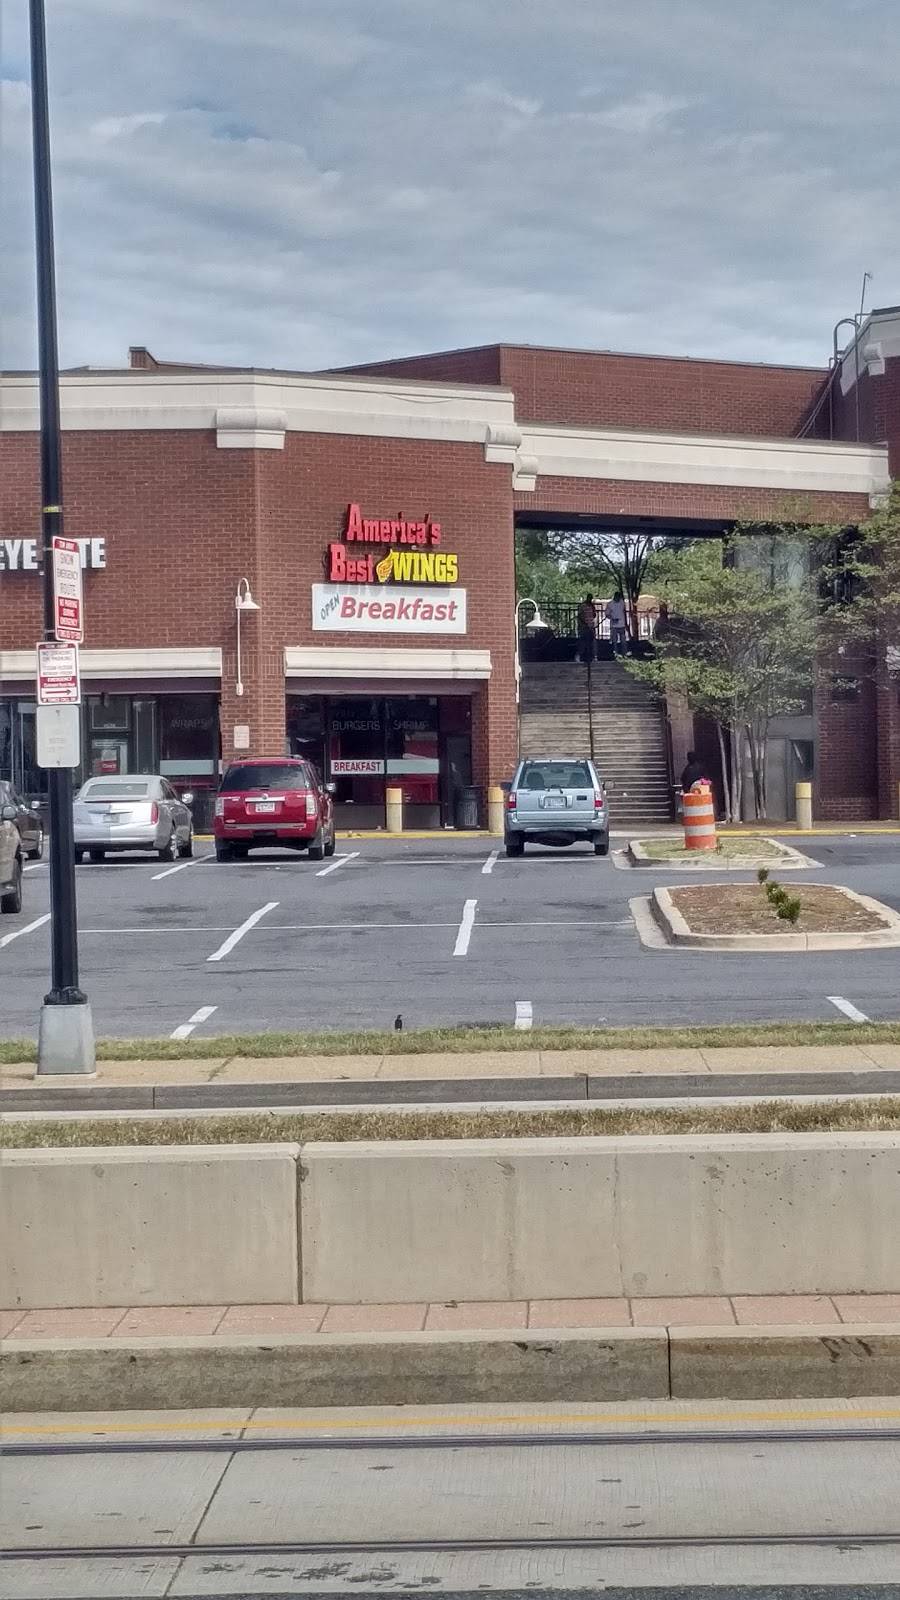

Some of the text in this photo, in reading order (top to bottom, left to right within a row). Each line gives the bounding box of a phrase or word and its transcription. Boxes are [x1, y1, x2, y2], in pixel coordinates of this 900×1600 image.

[346, 503, 441, 545] America's
[329, 543, 459, 583] Best WINGS
[320, 594, 340, 621] OPEN
[340, 596, 458, 621] Breakfast
[332, 720, 380, 731] BURGERS
[334, 761, 381, 772] BREAKFAST
